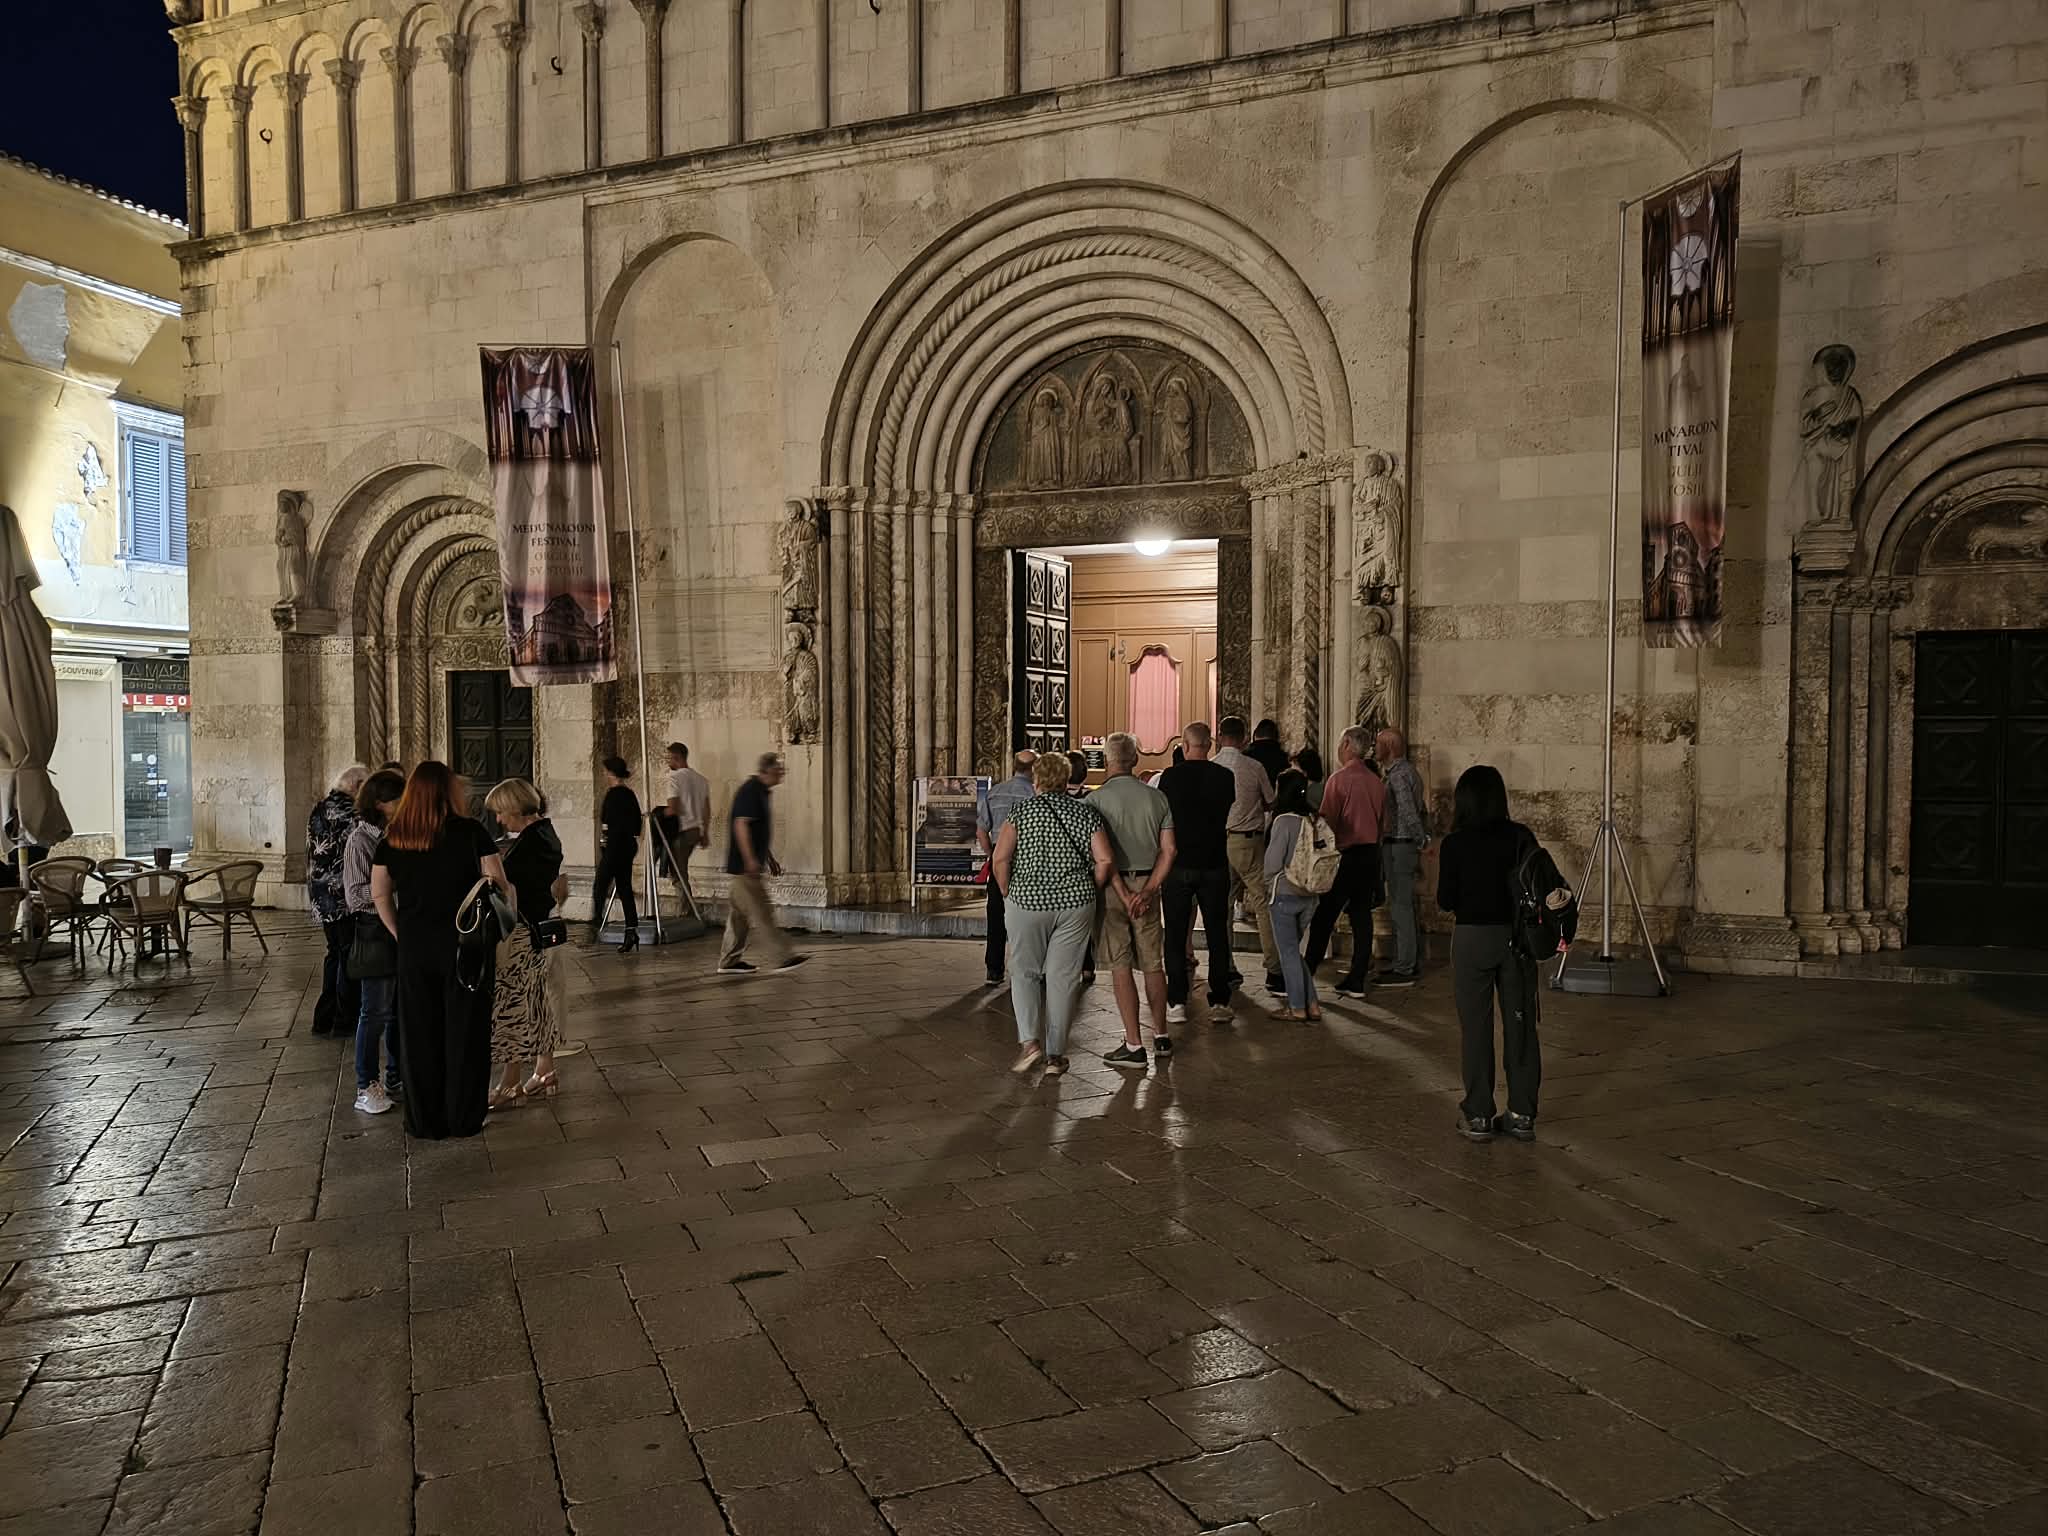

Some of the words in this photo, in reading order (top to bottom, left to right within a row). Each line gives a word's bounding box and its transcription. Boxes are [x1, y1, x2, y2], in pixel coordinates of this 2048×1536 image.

[531, 536, 580, 547] FESTIVAL
[62, 666, 104, 676] SOUVENIRS
[165, 695, 187, 706] 50
